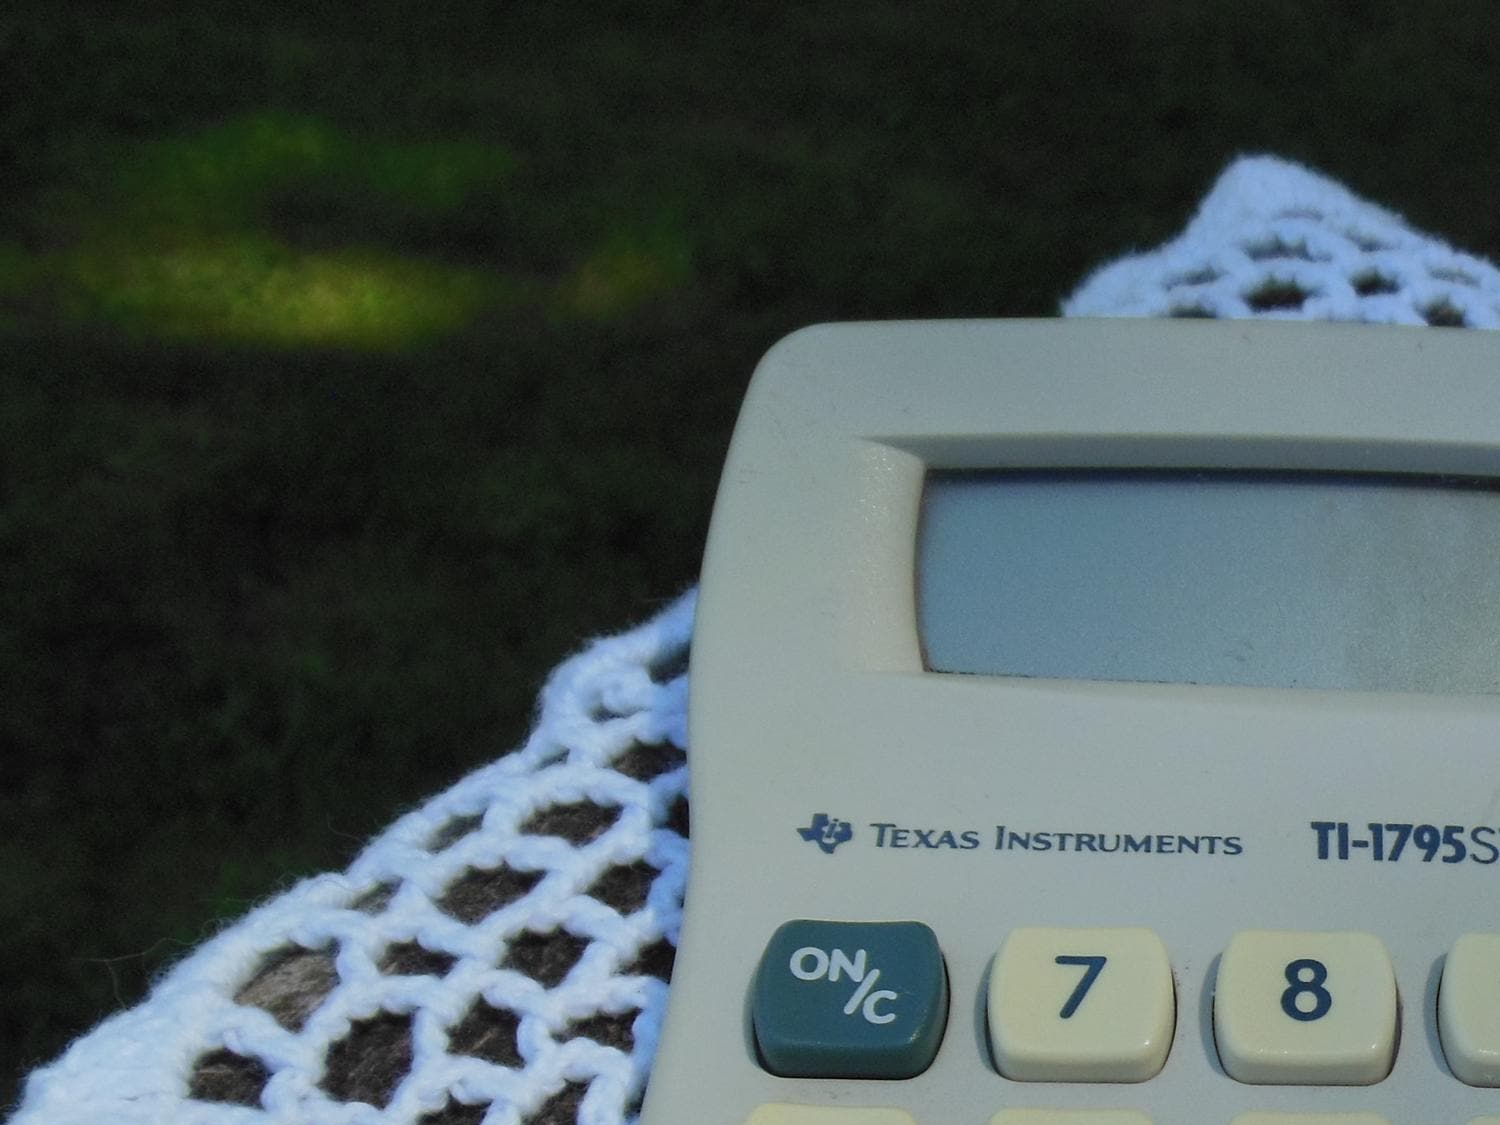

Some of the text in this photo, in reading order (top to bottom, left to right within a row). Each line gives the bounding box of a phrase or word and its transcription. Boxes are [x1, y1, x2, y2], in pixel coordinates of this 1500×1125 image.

[870, 823, 1244, 856] TEXAS INSTRUMENTS
[1055, 956, 1108, 1020] 7
[1281, 959, 1333, 1022] 8
